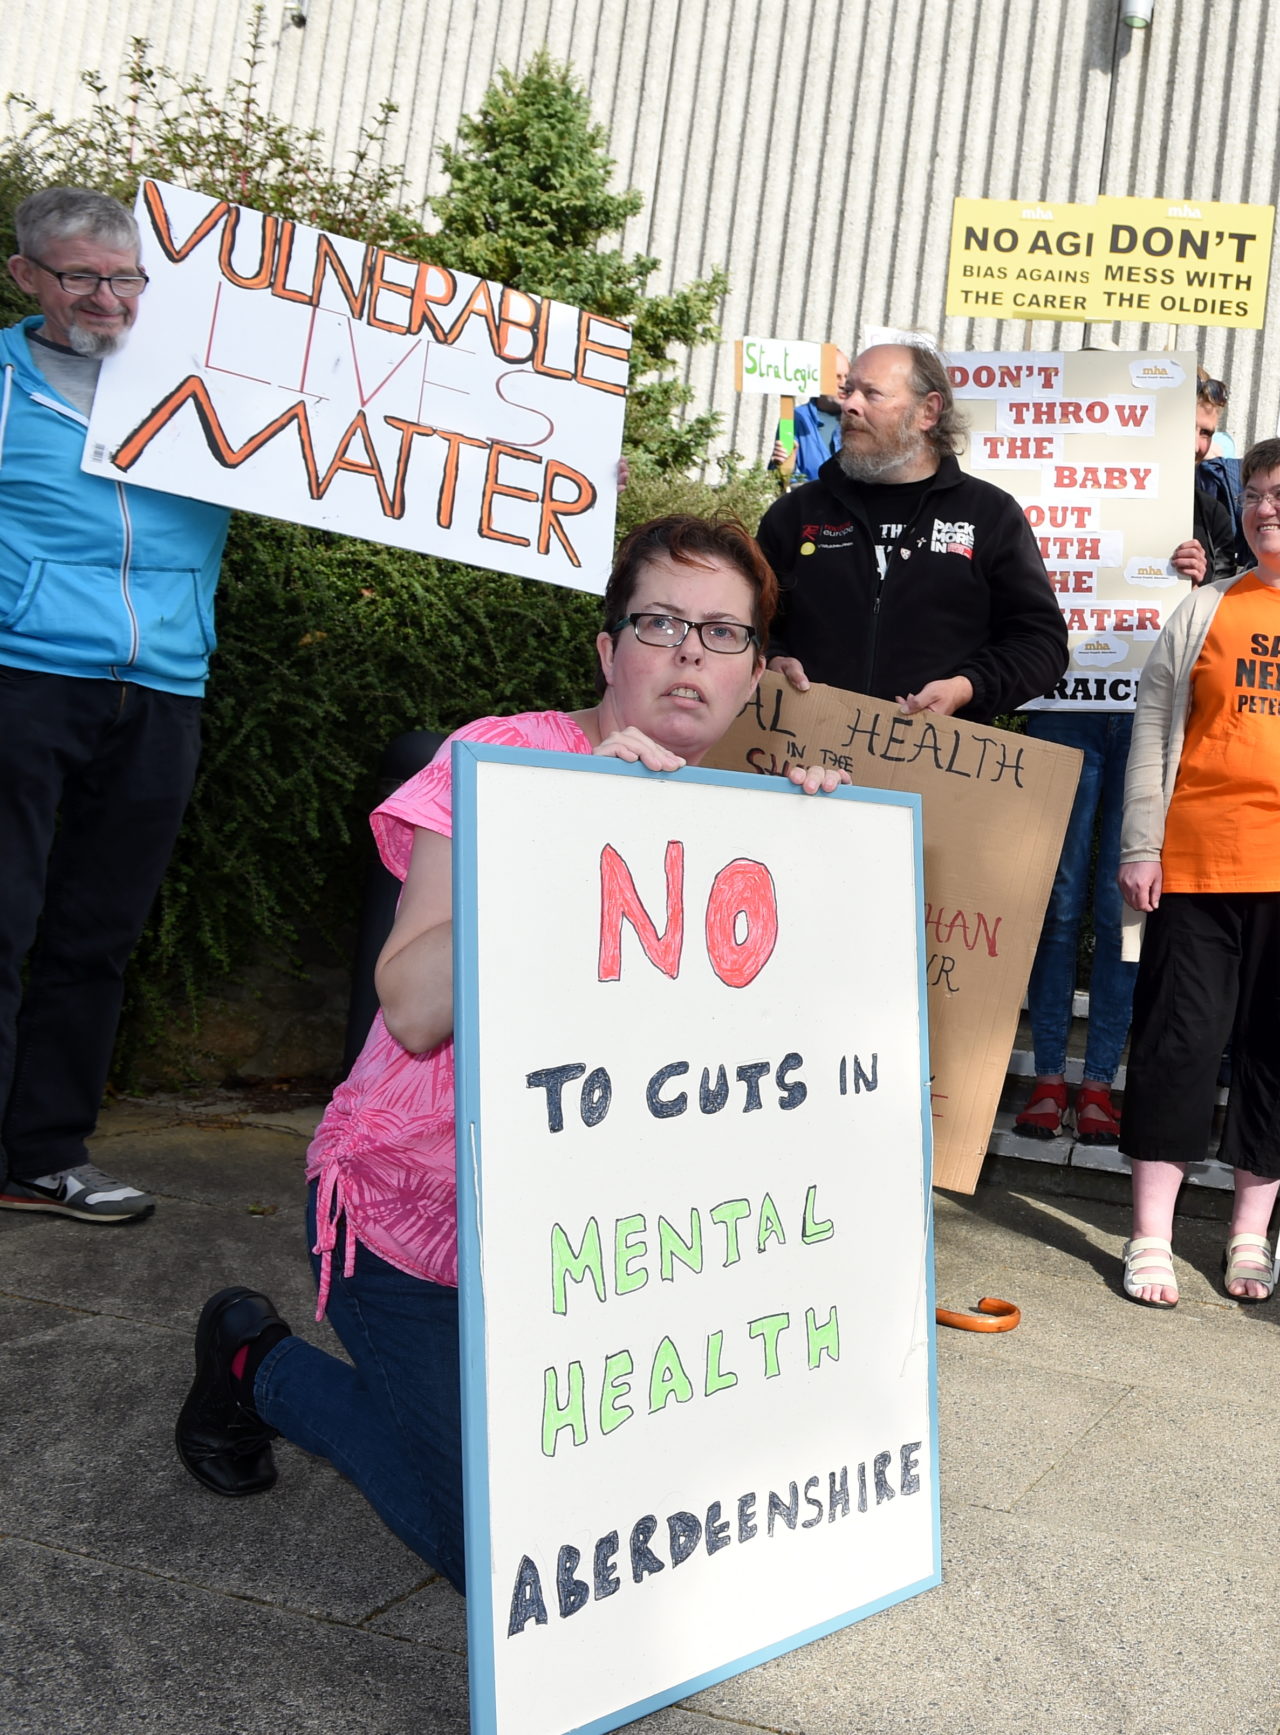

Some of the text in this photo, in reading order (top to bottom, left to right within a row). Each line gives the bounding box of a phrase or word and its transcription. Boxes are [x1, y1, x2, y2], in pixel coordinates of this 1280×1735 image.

[964, 226, 1094, 257] NO AGI
[1109, 224, 1256, 262] DON'T
[962, 265, 1090, 283] BIAS AGAINS
[1104, 265, 1252, 291] MESS WITH
[144, 180, 631, 395] VULNERABLE
[961, 290, 1087, 310] THE CARER
[1103, 291, 1249, 317] THE OLDIES
[205, 281, 553, 446] LIVES
[745, 343, 818, 392] Strategic
[946, 366, 1059, 389] DON'T
[1009, 401, 1148, 427] THROW
[984, 437, 1053, 459] THE
[111, 376, 596, 567] MATTER
[1054, 466, 1151, 490] BABY
[933, 518, 975, 537] PACK
[1024, 505, 1091, 528] OUT
[931, 540, 947, 553] IN
[932, 530, 974, 549] MORE
[1036, 537, 1101, 559] ITH
[1047, 571, 1093, 592] HE
[1060, 608, 1161, 631] ATER
[1044, 678, 1139, 702] RAIC
[842, 708, 1024, 788] HEALTH
[598, 840, 778, 988] NO
[925, 903, 1002, 957] HAN
[526, 1053, 878, 1133] TO CUTS IN
[551, 1185, 834, 1315] MENTAL
[541, 1306, 840, 1457] HEALTH
[507, 1441, 922, 1639] ABERDEENSHIRE
